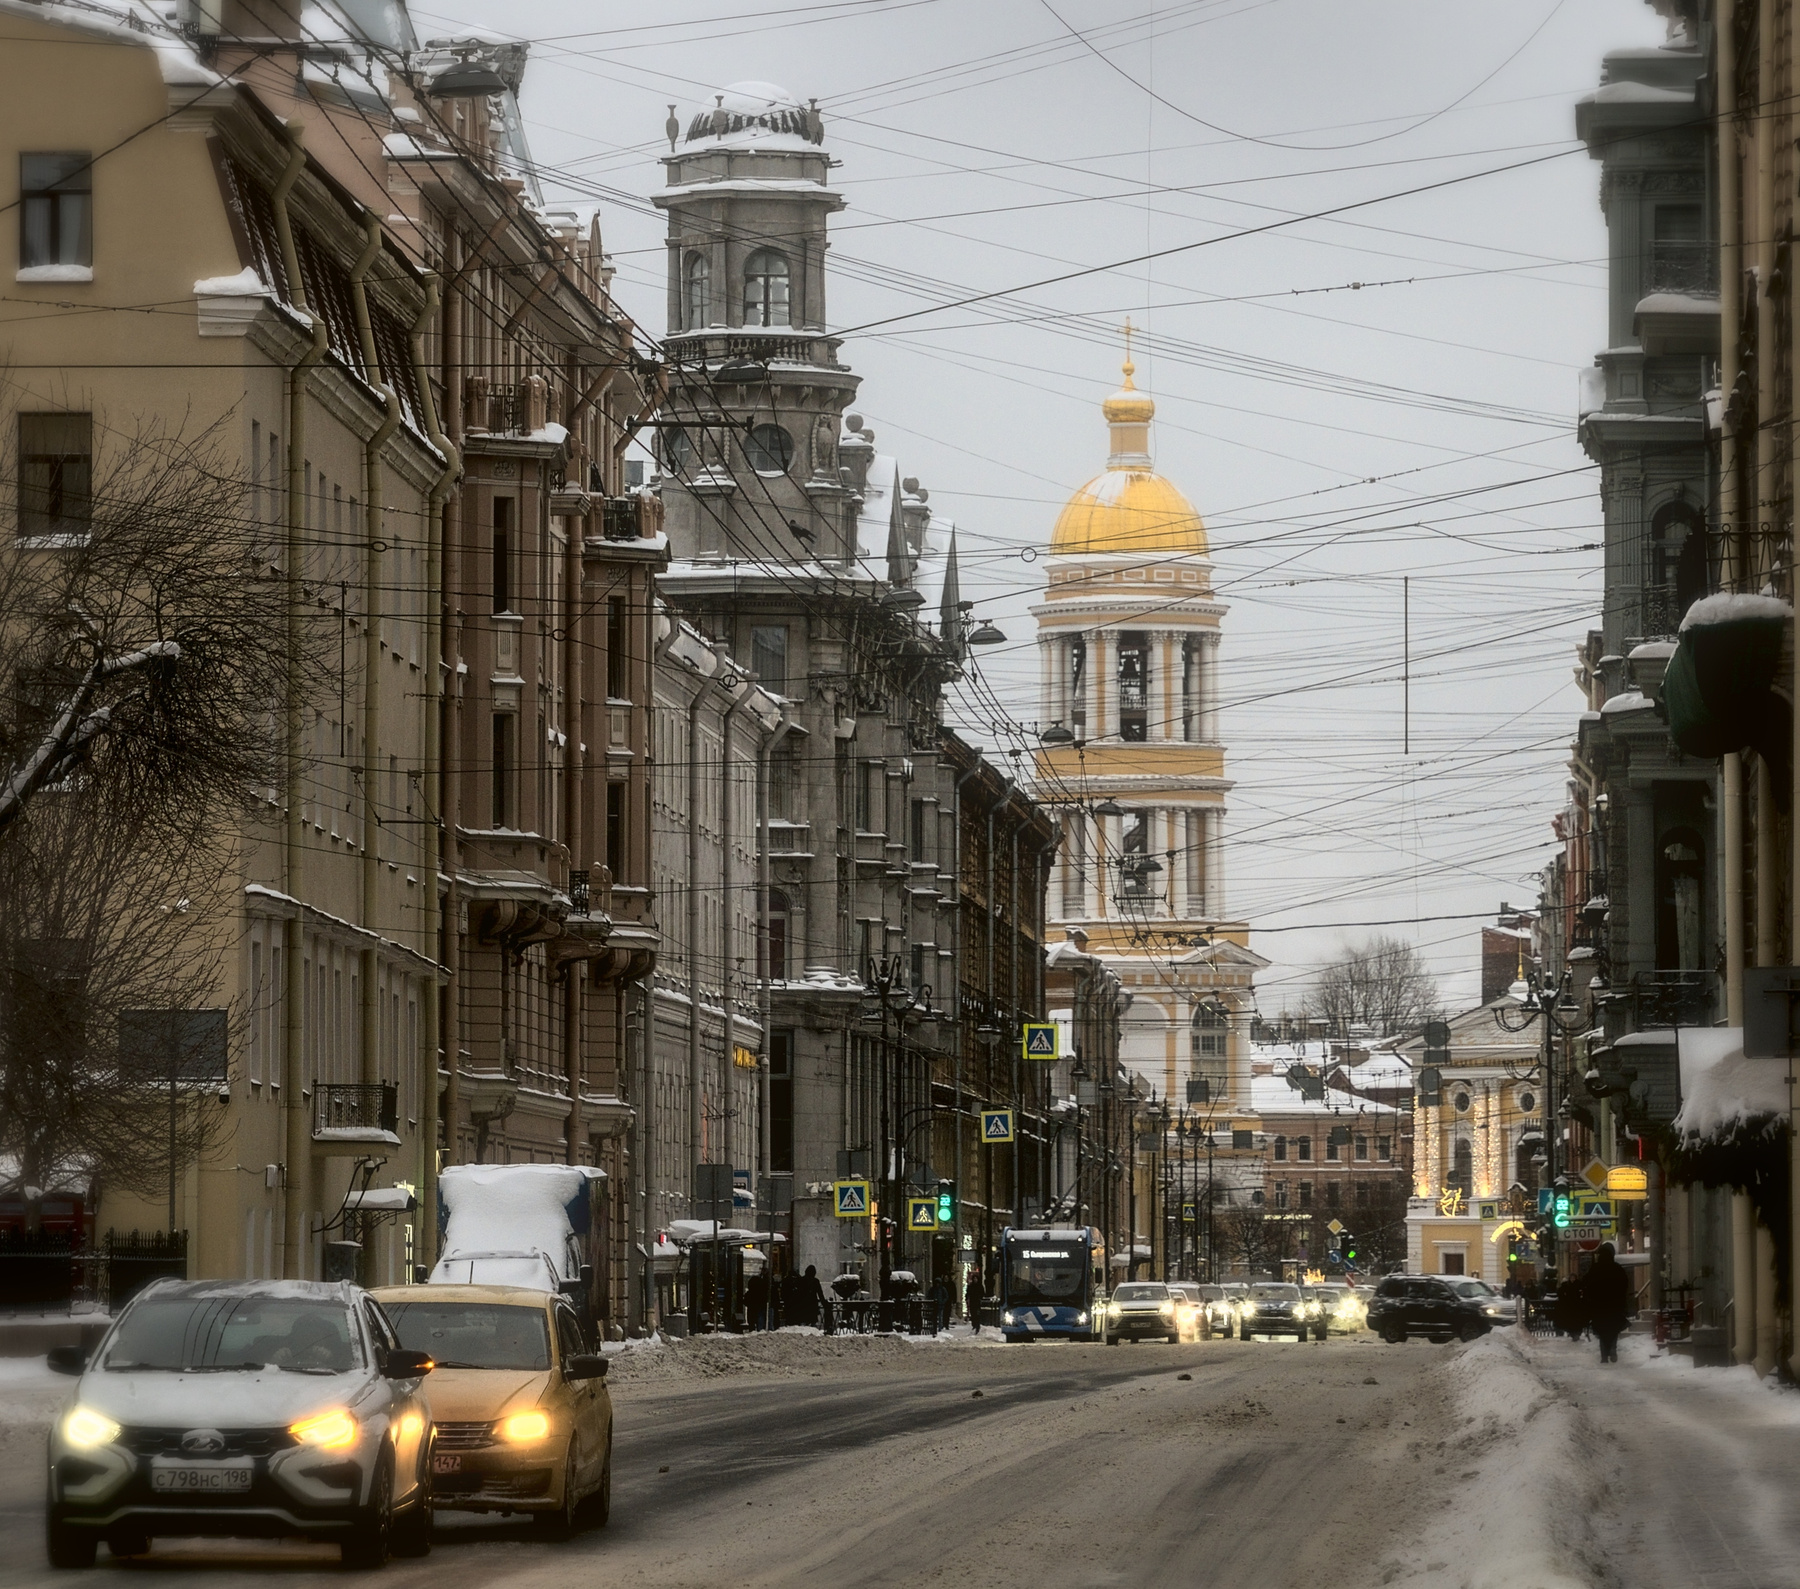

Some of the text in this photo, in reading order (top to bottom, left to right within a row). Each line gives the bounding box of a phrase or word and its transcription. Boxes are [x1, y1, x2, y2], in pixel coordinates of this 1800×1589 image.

[1556, 1199, 1569, 1210] 22
[1563, 1228, 1595, 1239] СТОП
[1022, 1251, 1030, 1259] 15
[435, 1455, 457, 1468] 147
[156, 1471, 247, 1488] С798НС 198
